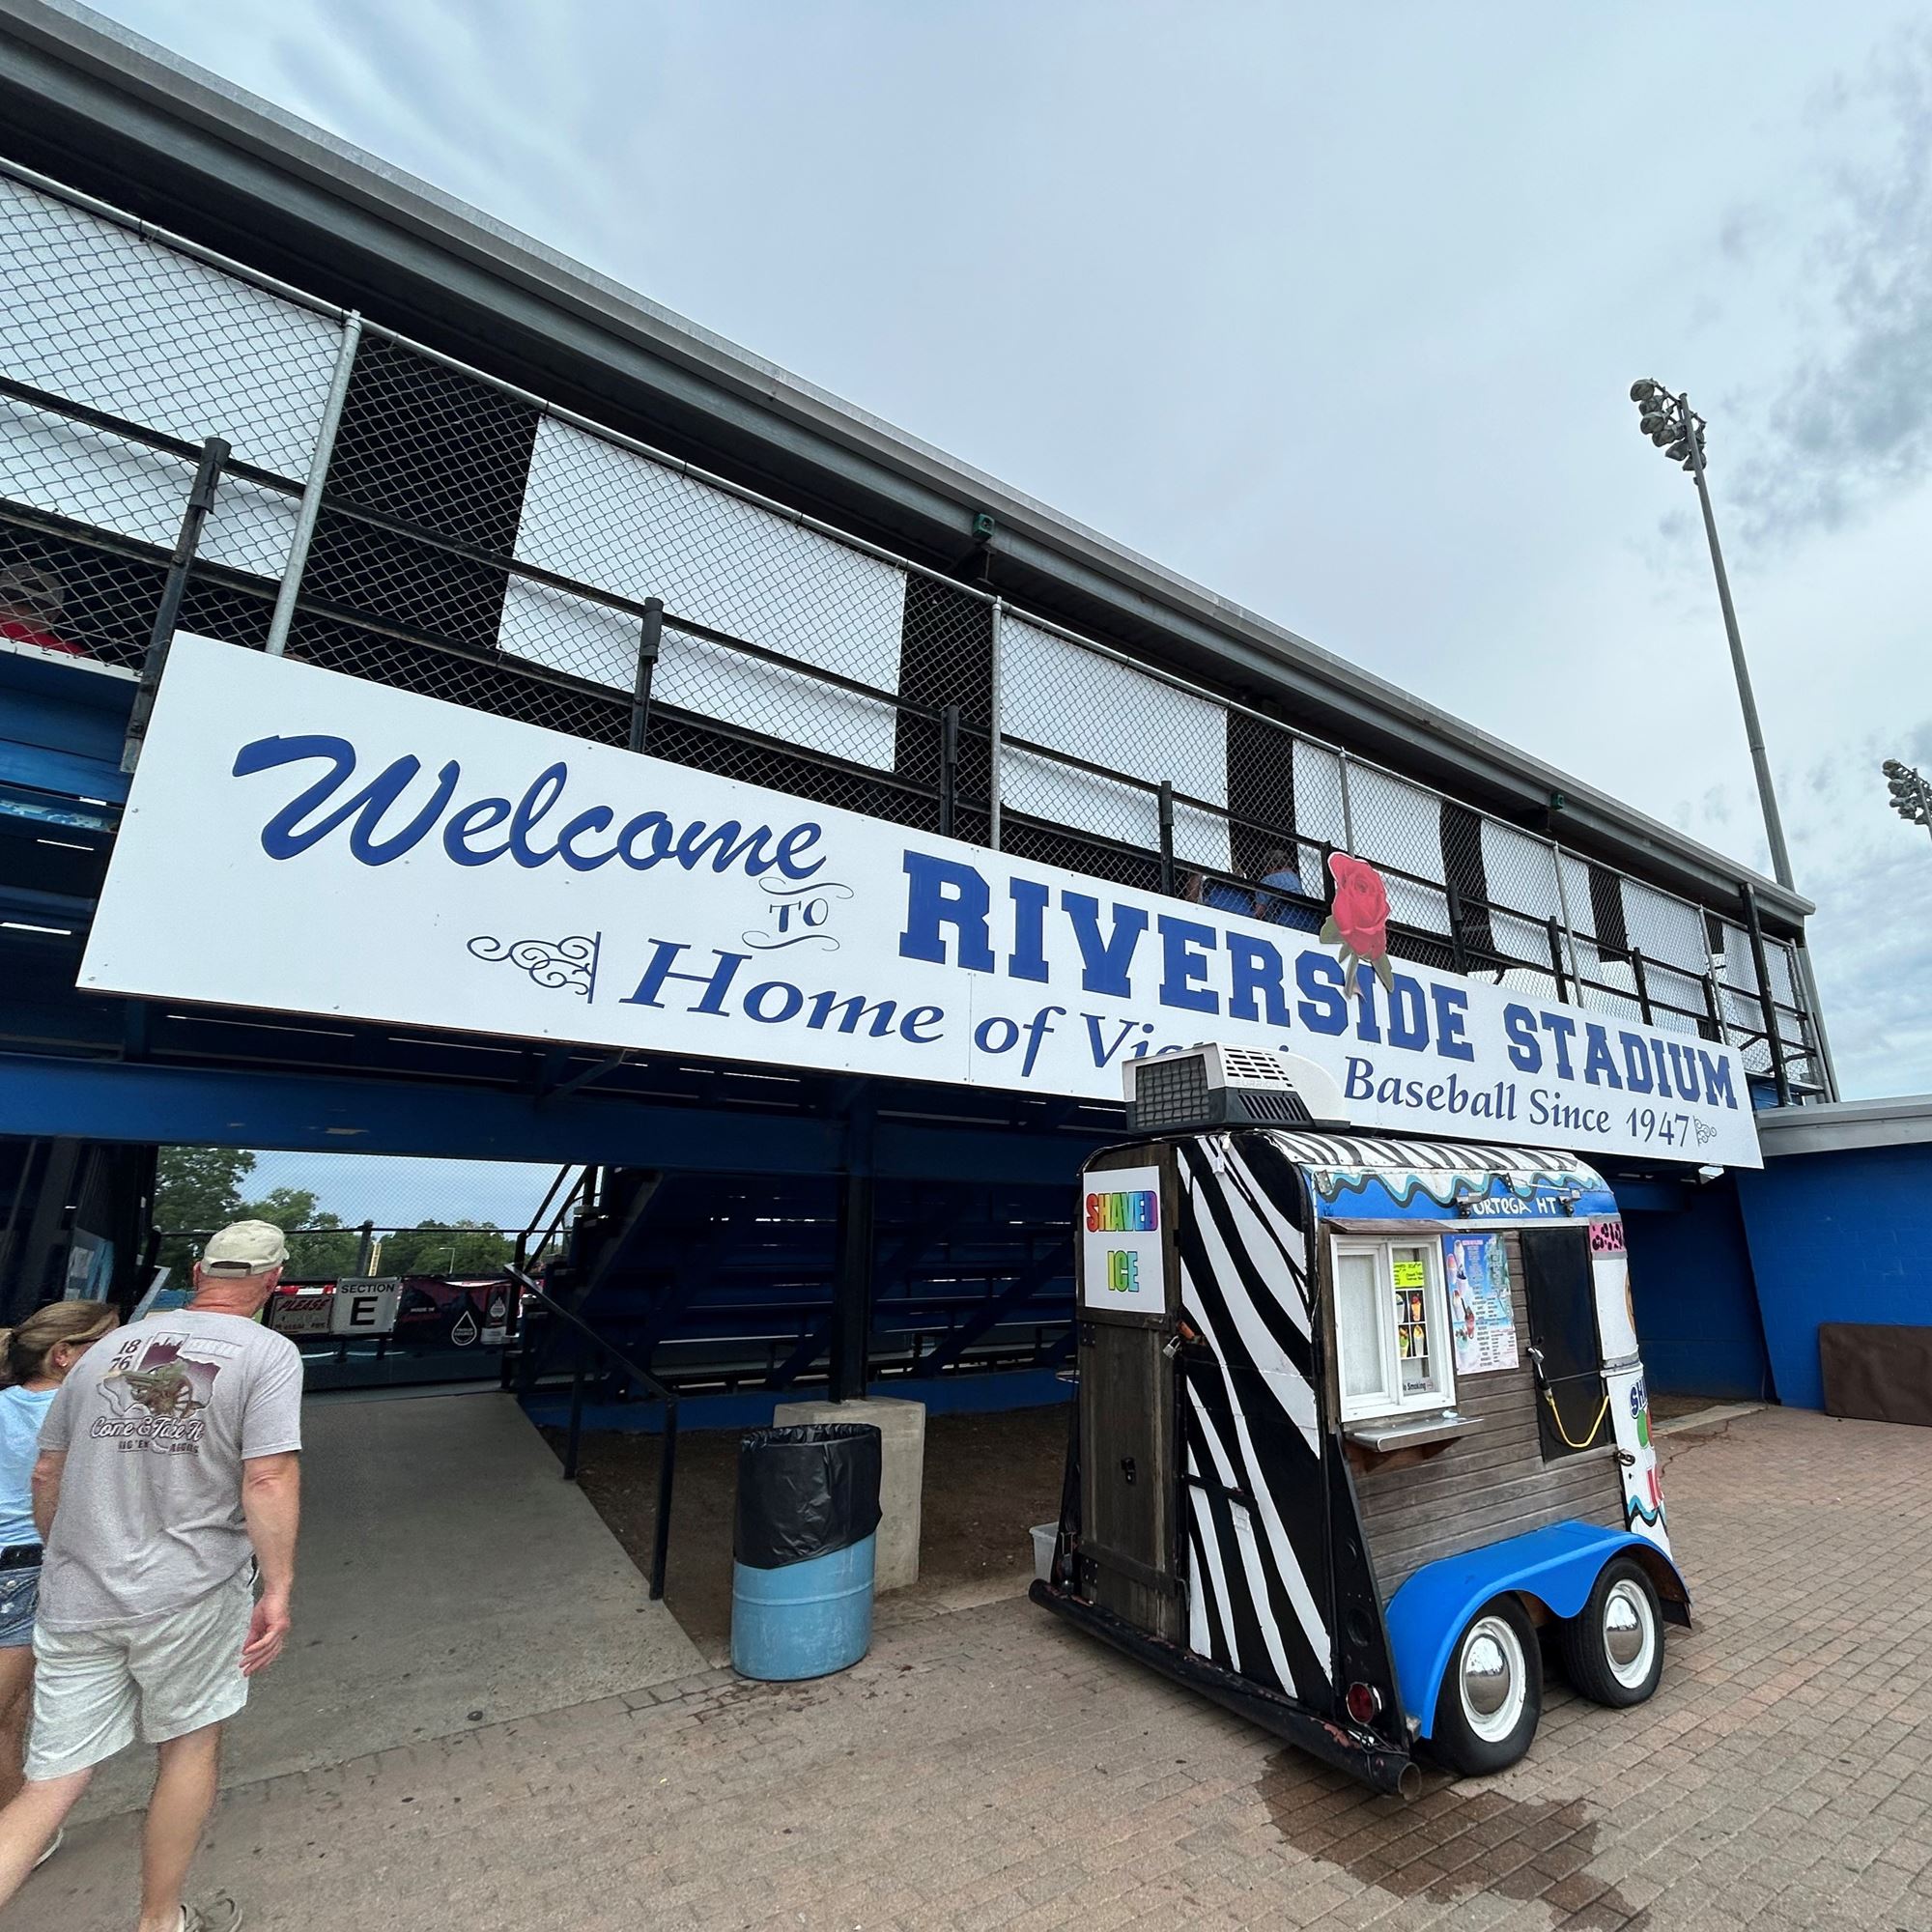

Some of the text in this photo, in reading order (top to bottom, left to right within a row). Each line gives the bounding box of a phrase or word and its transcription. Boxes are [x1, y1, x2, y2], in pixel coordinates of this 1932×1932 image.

[232, 734, 827, 880] Welcome
[769, 897, 829, 933] TO
[898, 849, 1738, 1110] RIVERSIDE STADIUM
[618, 937, 943, 1049] Home
[974, 1006, 1067, 1077] of
[1345, 1056, 1690, 1148] Baseball Since 1947
[1086, 1190, 1158, 1233] SHAVED
[341, 1284, 395, 1294] SECTION
[1107, 1250, 1140, 1293] ICE
[277, 1298, 330, 1312] PLEASE
[350, 1296, 379, 1325] E
[118, 1339, 142, 1354] 18
